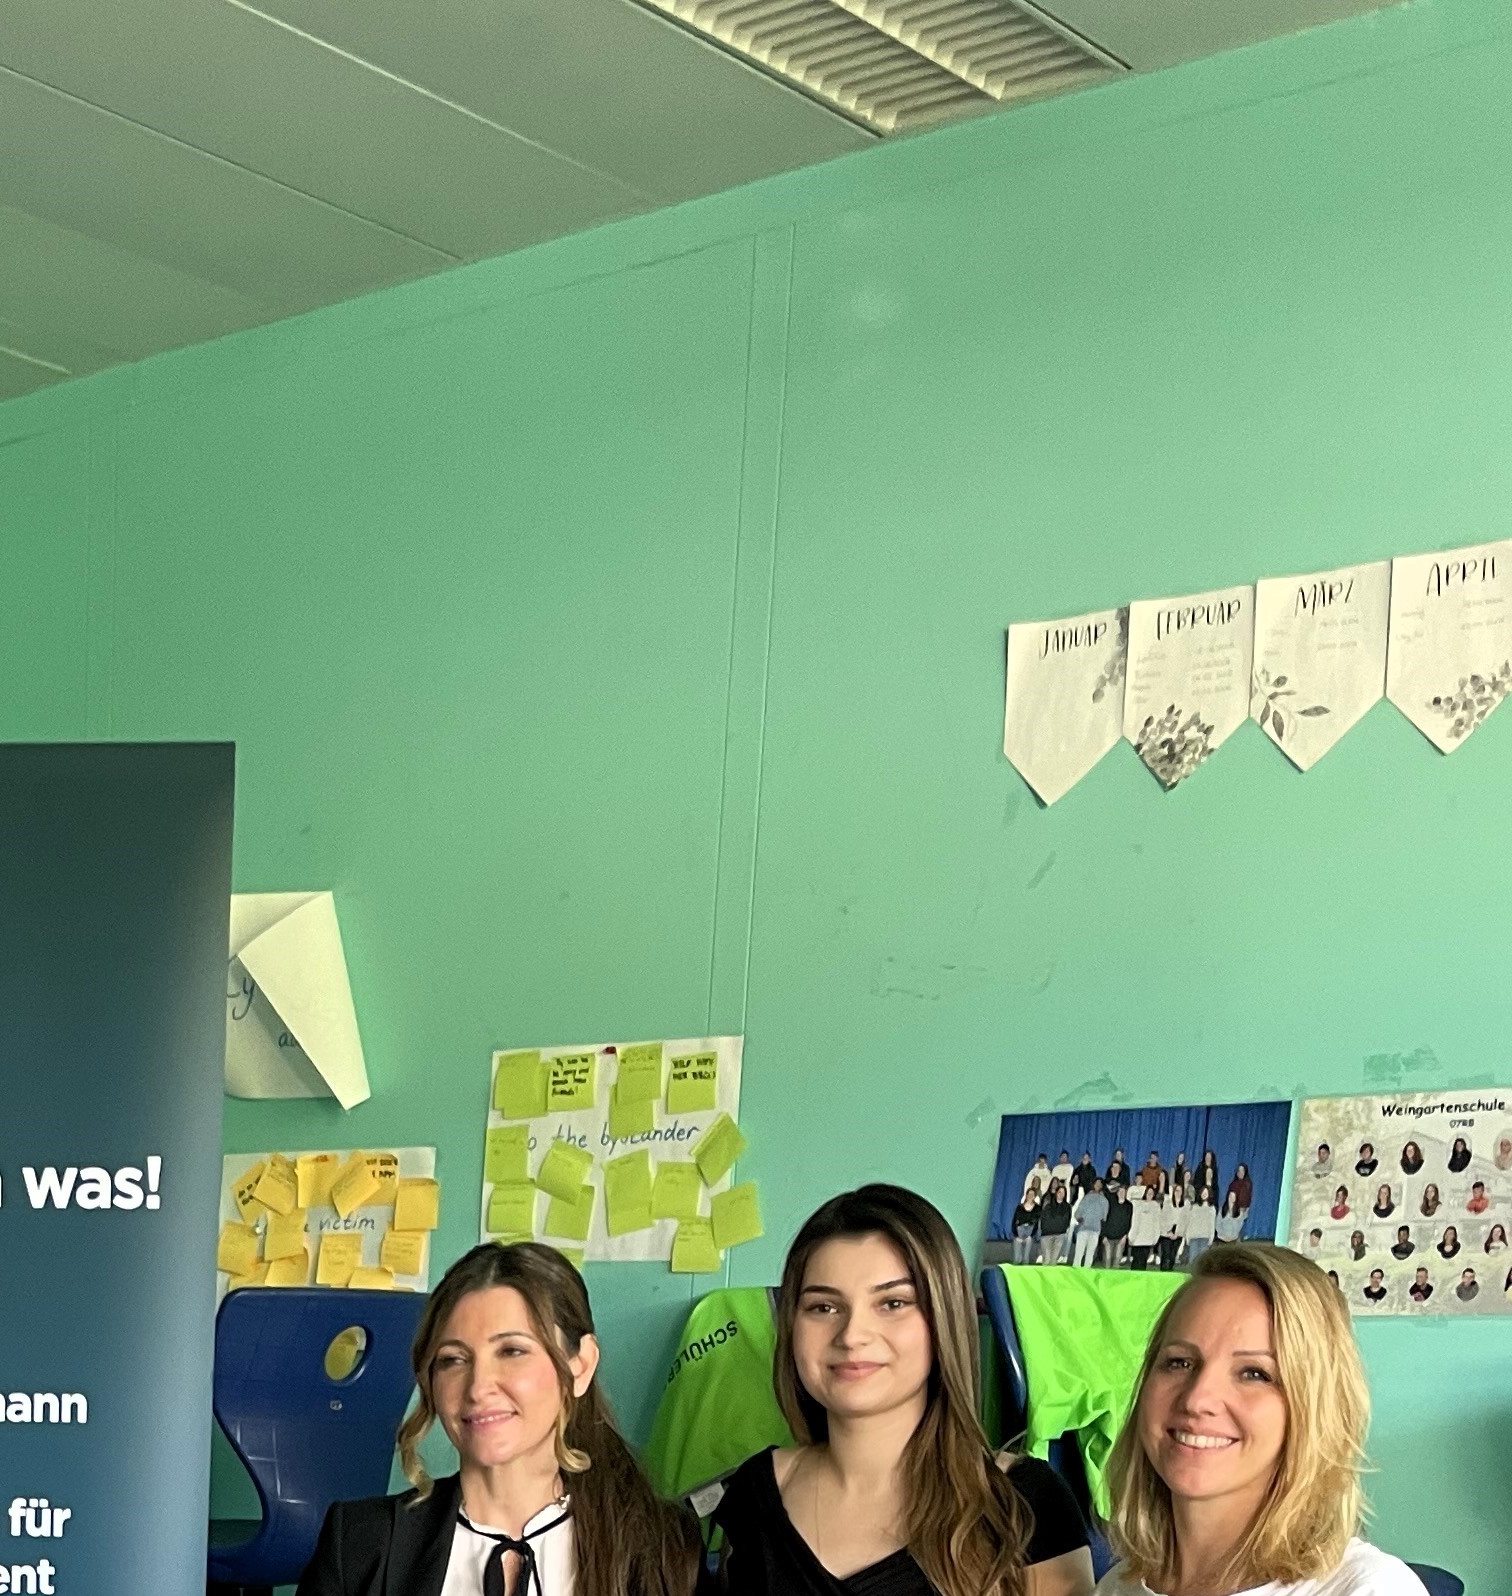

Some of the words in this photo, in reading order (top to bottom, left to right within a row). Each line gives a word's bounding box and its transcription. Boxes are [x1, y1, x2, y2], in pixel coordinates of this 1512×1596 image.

[1039, 621, 1108, 661] JANUAR
[1380, 1097, 1507, 1120] Weingartenschule
[550, 1123, 588, 1150] the
[21, 1155, 164, 1212] was!
[318, 1216, 376, 1232] victim
[7, 1497, 73, 1539] für
